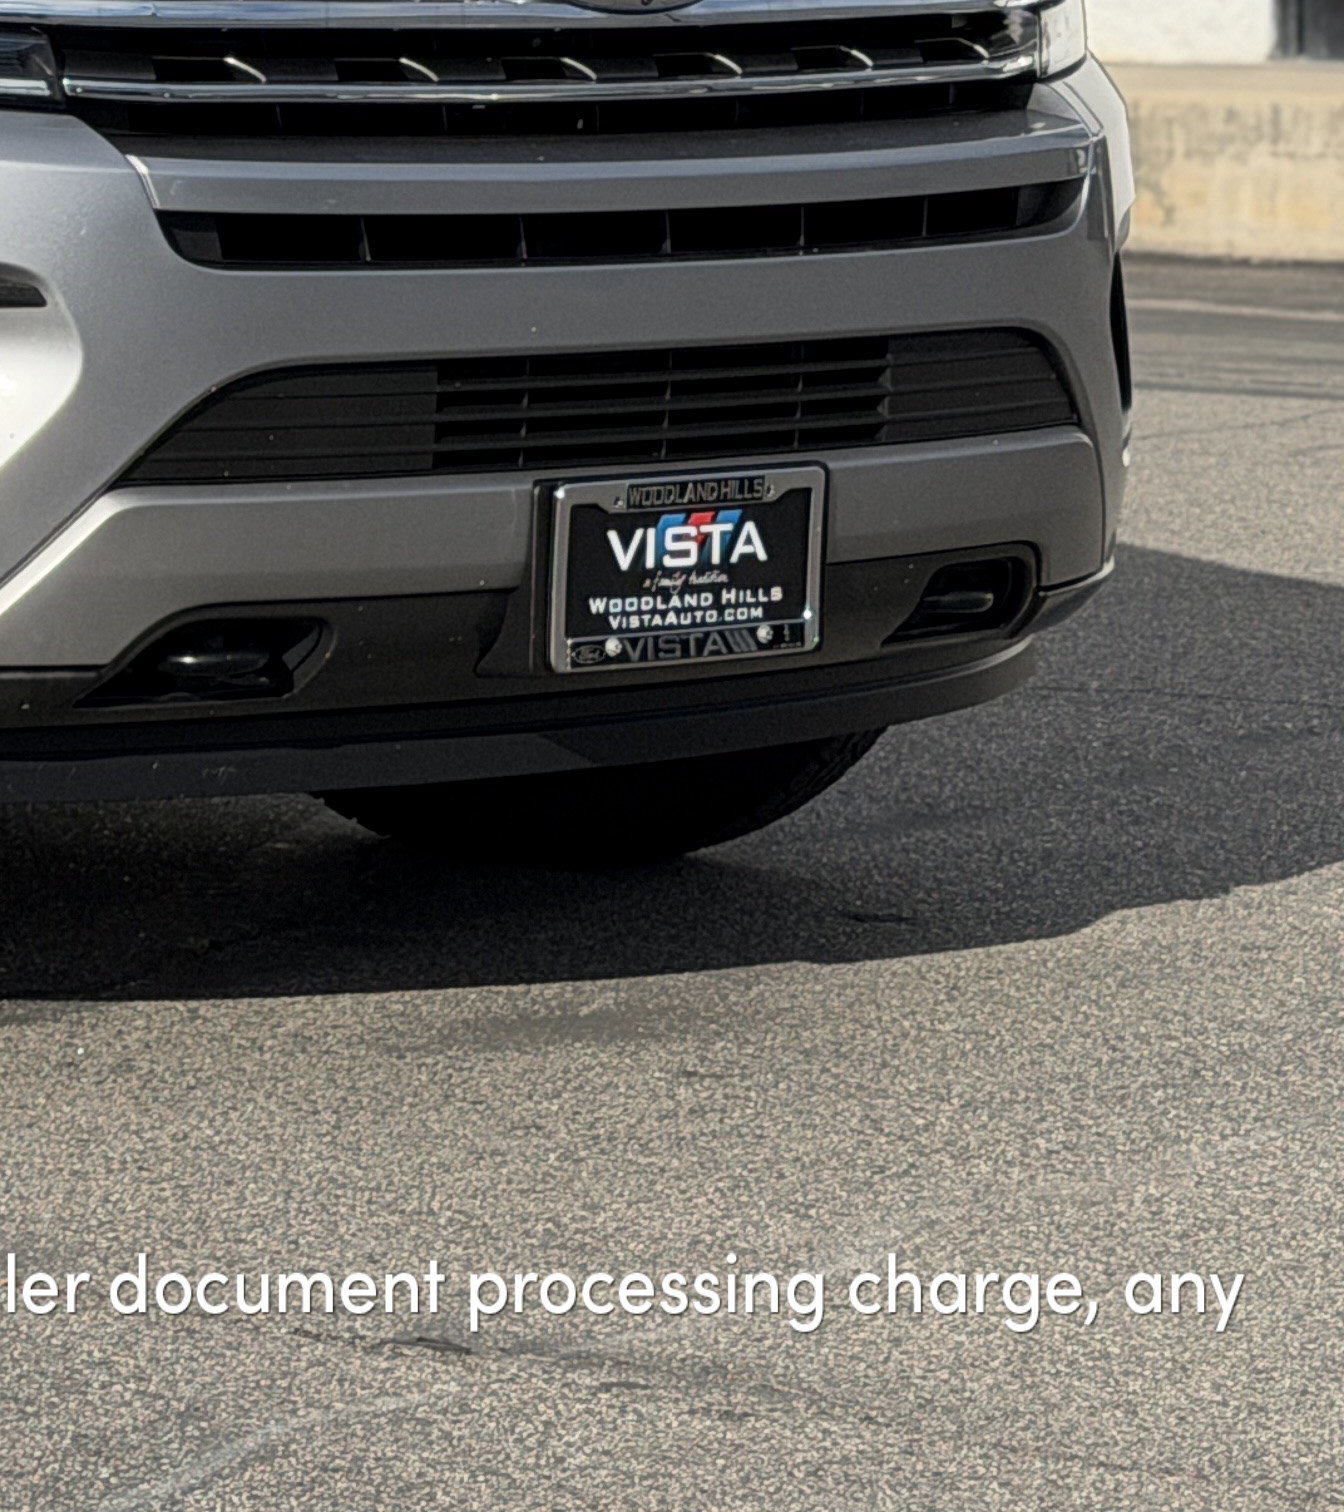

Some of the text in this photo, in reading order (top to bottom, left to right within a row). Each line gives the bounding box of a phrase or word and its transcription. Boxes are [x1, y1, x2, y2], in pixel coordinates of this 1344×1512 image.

[628, 477, 765, 507] WOODLAND HILLS
[606, 520, 768, 572] VISTA
[622, 630, 728, 663] VISTA
